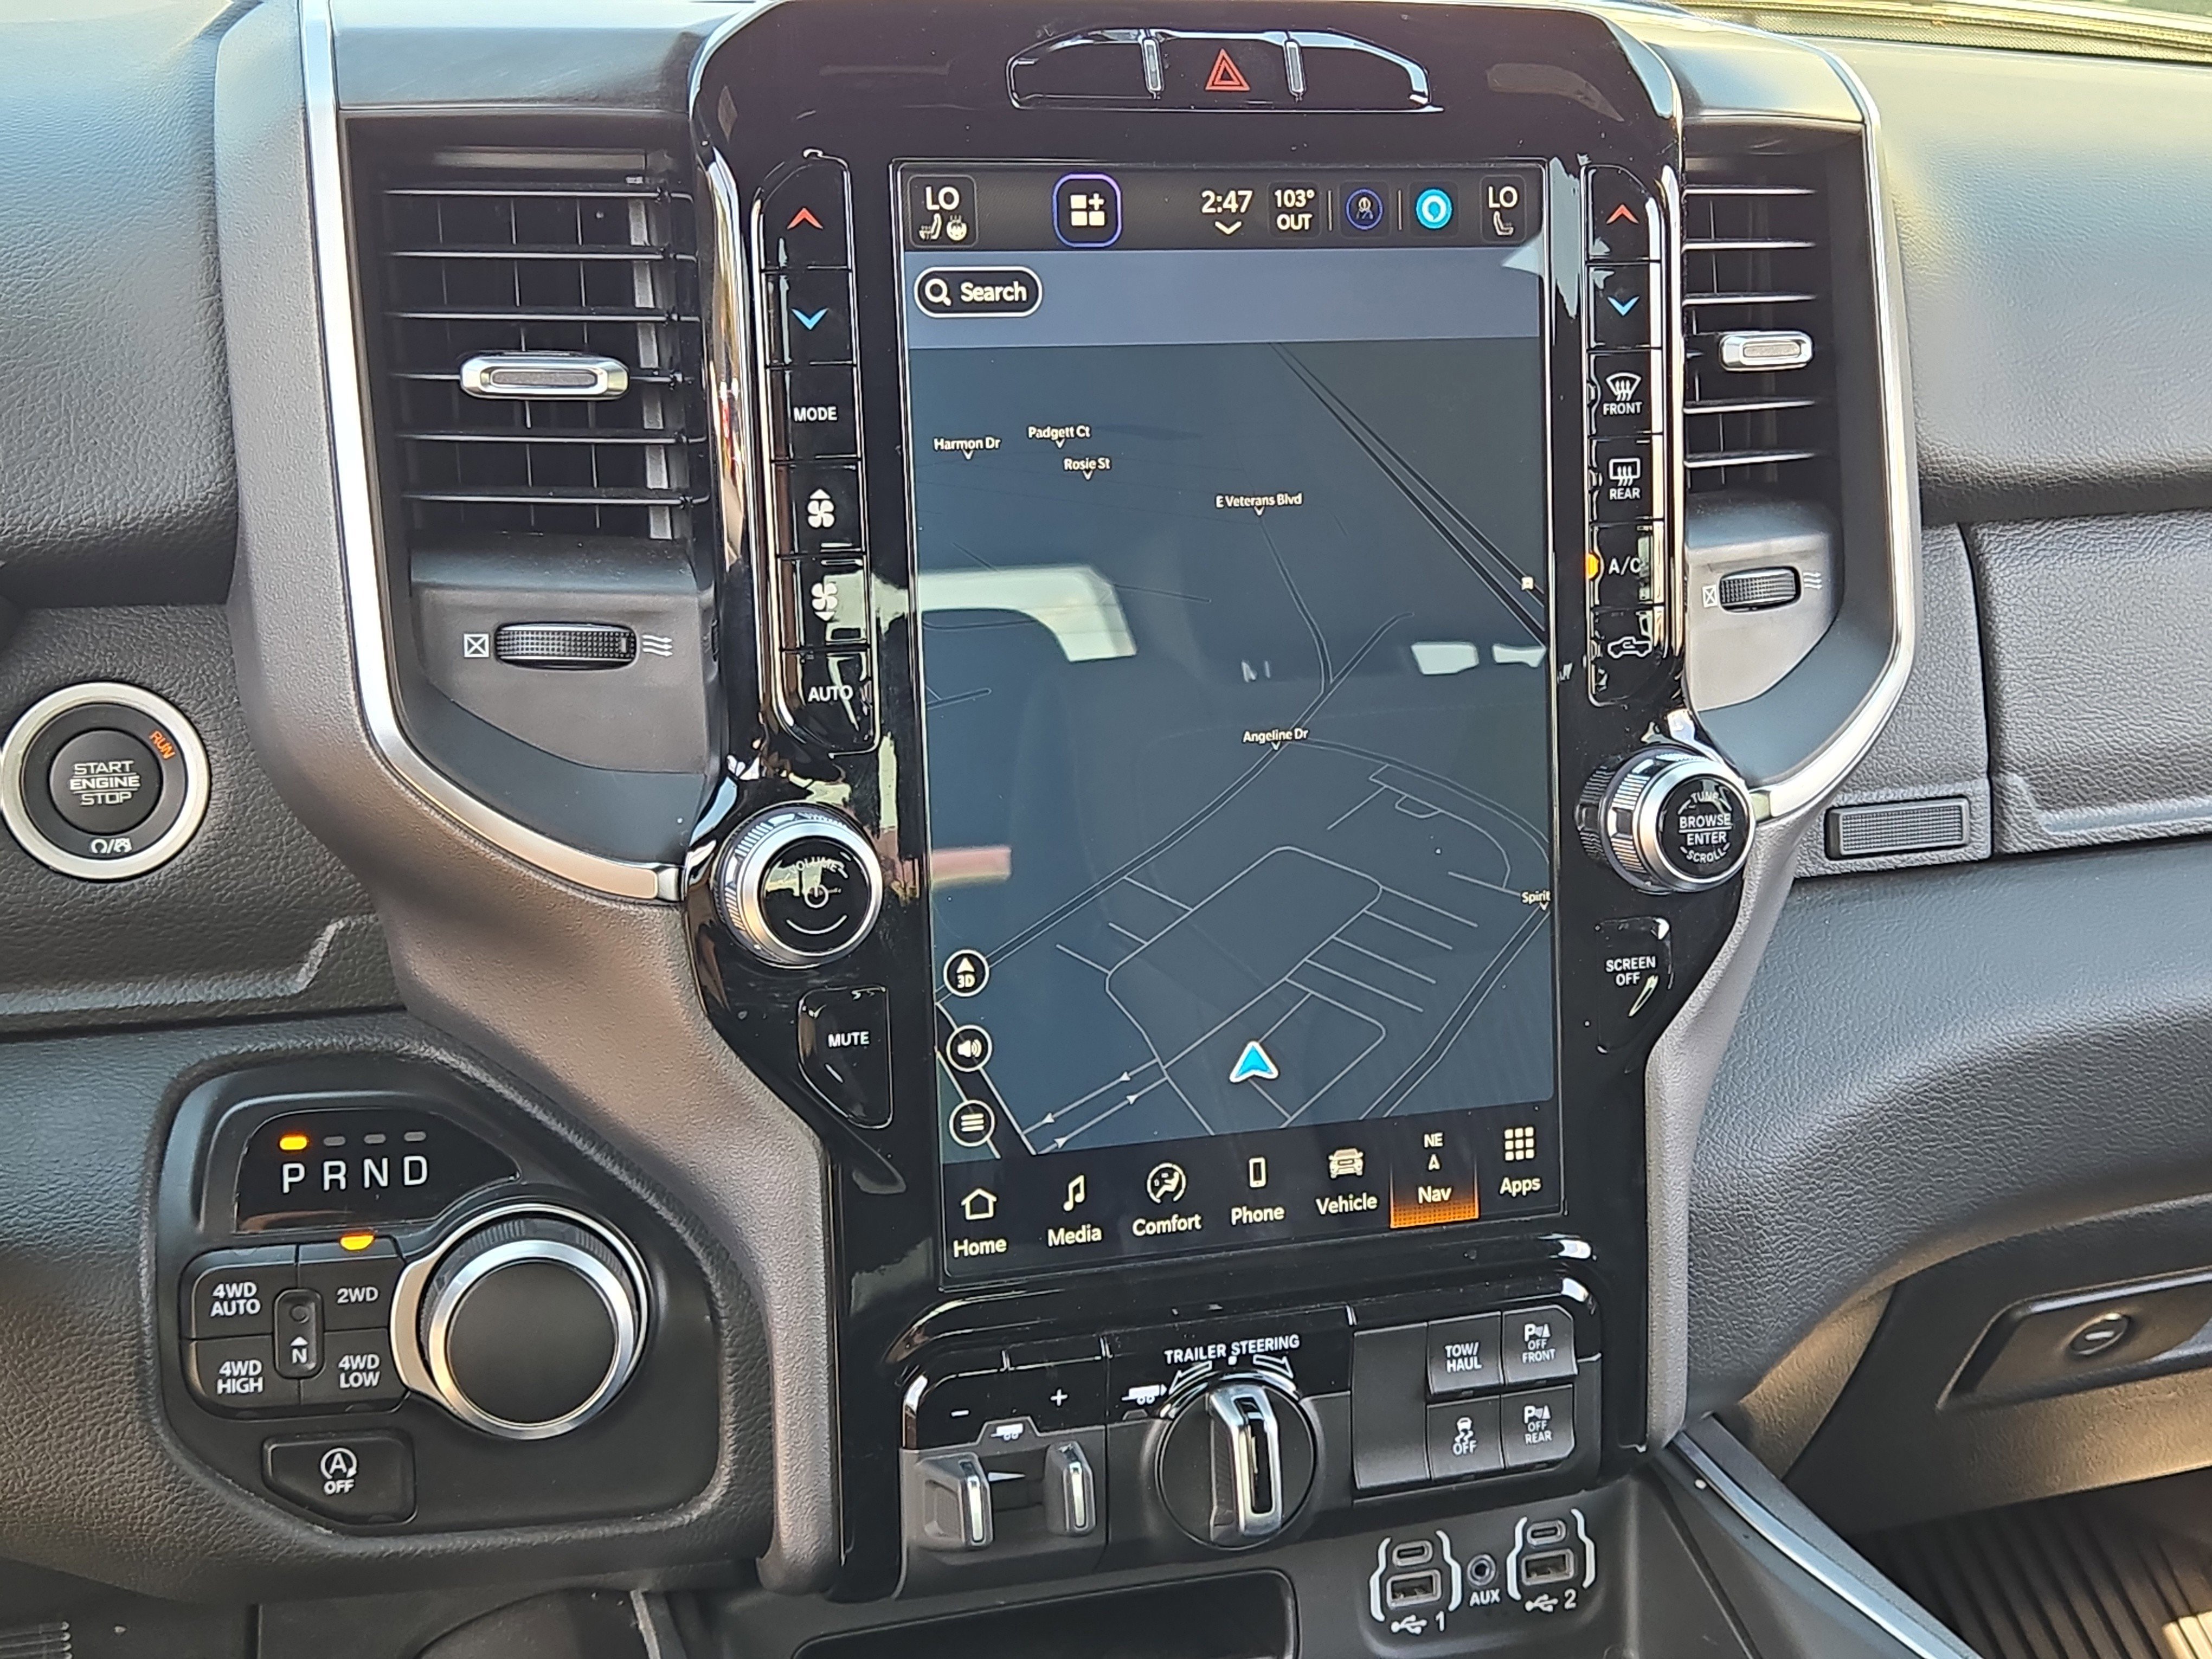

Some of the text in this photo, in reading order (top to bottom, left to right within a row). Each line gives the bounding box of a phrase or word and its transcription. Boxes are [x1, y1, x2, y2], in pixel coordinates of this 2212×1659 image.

[925, 186, 960, 210] LO
[1201, 190, 1253, 213] 2:47
[1488, 186, 1517, 209] LO
[1276, 213, 1313, 230] OUT
[960, 280, 1027, 303] Search
[793, 406, 839, 422] MODE
[1603, 401, 1643, 416] FRONT
[1028, 425, 1092, 440] Padgett Ct
[934, 436, 1001, 451] Harmon Dr
[1064, 457, 1111, 471] Rosie St
[1216, 492, 1303, 508] E Veterans Blvd
[1609, 488, 1641, 501] REAR
[1608, 556, 1642, 576] A/C
[808, 685, 854, 702] AUTO
[1243, 728, 1309, 744] Angeline Dr
[149, 730, 176, 760] RUN
[74, 760, 134, 775] START
[70, 775, 140, 790] ENGINE
[80, 791, 132, 807] STOP
[1690, 790, 1720, 803] TUNE
[1679, 813, 1732, 829] BROWSE
[1686, 831, 1727, 846] ENTER
[1686, 848, 1727, 864] SCROLL
[1521, 890, 1551, 904] Spirit
[1606, 956, 1656, 972] SCREEN
[957, 976, 975, 988] 3D
[1616, 972, 1641, 987] OFF
[828, 1031, 870, 1047] MUTE
[1424, 1133, 1444, 1147] NE
[282, 1155, 428, 1193] P R N D
[1500, 1177, 1541, 1197] Apps
[1418, 1186, 1452, 1205] Nav
[1315, 1193, 1378, 1216] Vehicle
[1231, 1206, 1285, 1225] Phone
[1132, 1213, 1202, 1236] Comfort
[1047, 1225, 1103, 1246] Media
[953, 1238, 1007, 1259] Home
[213, 1282, 258, 1298] 4WD
[336, 1286, 379, 1304] 2WD
[210, 1298, 261, 1317] AUTO
[1163, 1334, 1300, 1365] TRAILER STEERING
[1444, 1342, 1480, 1358] TOW/
[1527, 1338, 1548, 1351] OFF
[292, 1348, 307, 1364] N
[338, 1354, 380, 1371] 4WD
[1522, 1348, 1556, 1363] FRONT
[218, 1359, 262, 1377] 4WD
[1446, 1358, 1482, 1373] HAUL
[216, 1377, 263, 1394] HIGH
[339, 1371, 381, 1388] LOW
[1527, 1420, 1548, 1432] OFF
[1525, 1430, 1553, 1445] REAR
[1452, 1439, 1477, 1456] OFF
[323, 1478, 355, 1495] OFF
[1469, 1589, 1501, 1607] AUX
[1564, 1589, 1578, 1609] 2
[1435, 1611, 1445, 1632] 1
